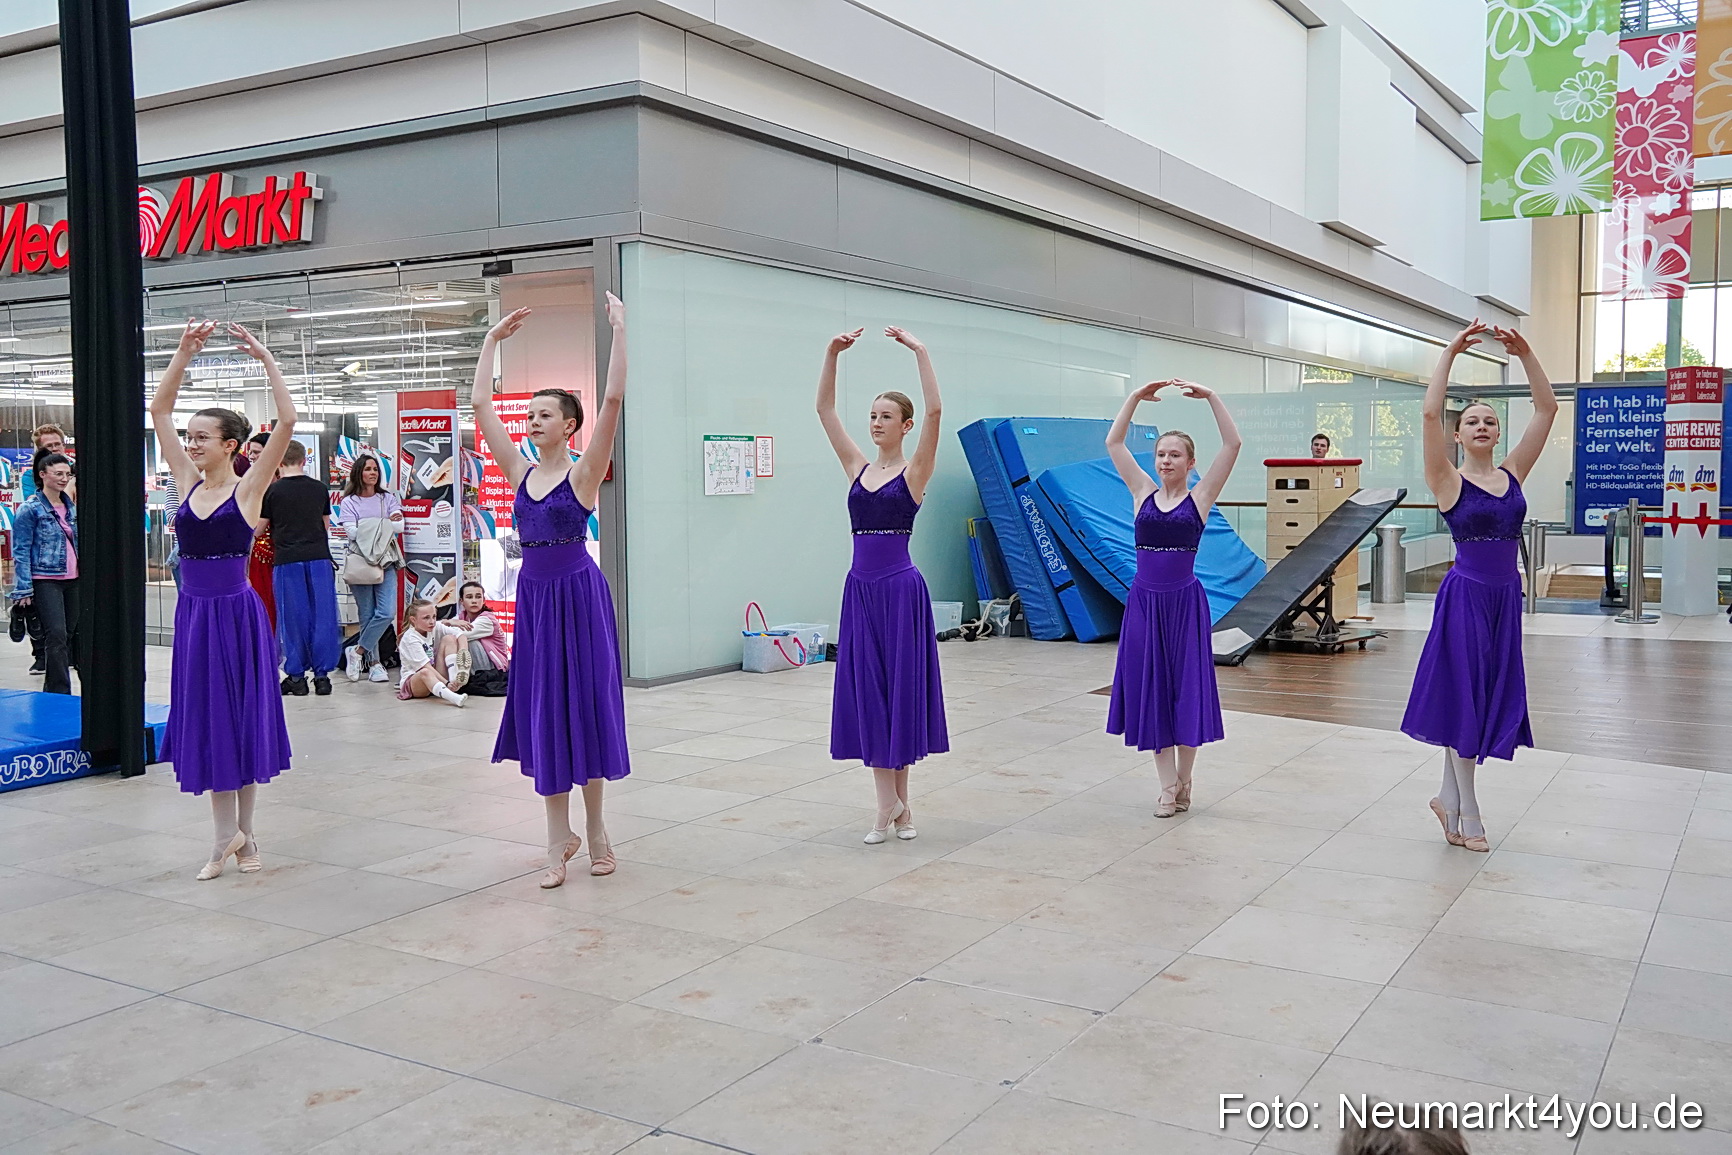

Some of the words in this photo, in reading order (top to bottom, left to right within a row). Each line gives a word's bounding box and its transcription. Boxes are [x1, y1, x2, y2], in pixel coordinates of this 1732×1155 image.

[147, 171, 319, 258] Markt
[1587, 396, 1609, 408] Ich
[1613, 395, 1642, 408] hab
[1586, 411, 1615, 423] den
[1586, 425, 1660, 438] Fernseher
[1665, 423, 1689, 437] REWE
[1690, 422, 1721, 436] REWE
[1585, 441, 1612, 453] der
[1615, 440, 1656, 453] Welt.
[1665, 438, 1689, 448] CENTER
[1690, 438, 1721, 448] CENTER
[1669, 464, 1684, 483] dm
[1695, 464, 1716, 483] dm
[1586, 482, 1644, 490] HD-Bildqualität
